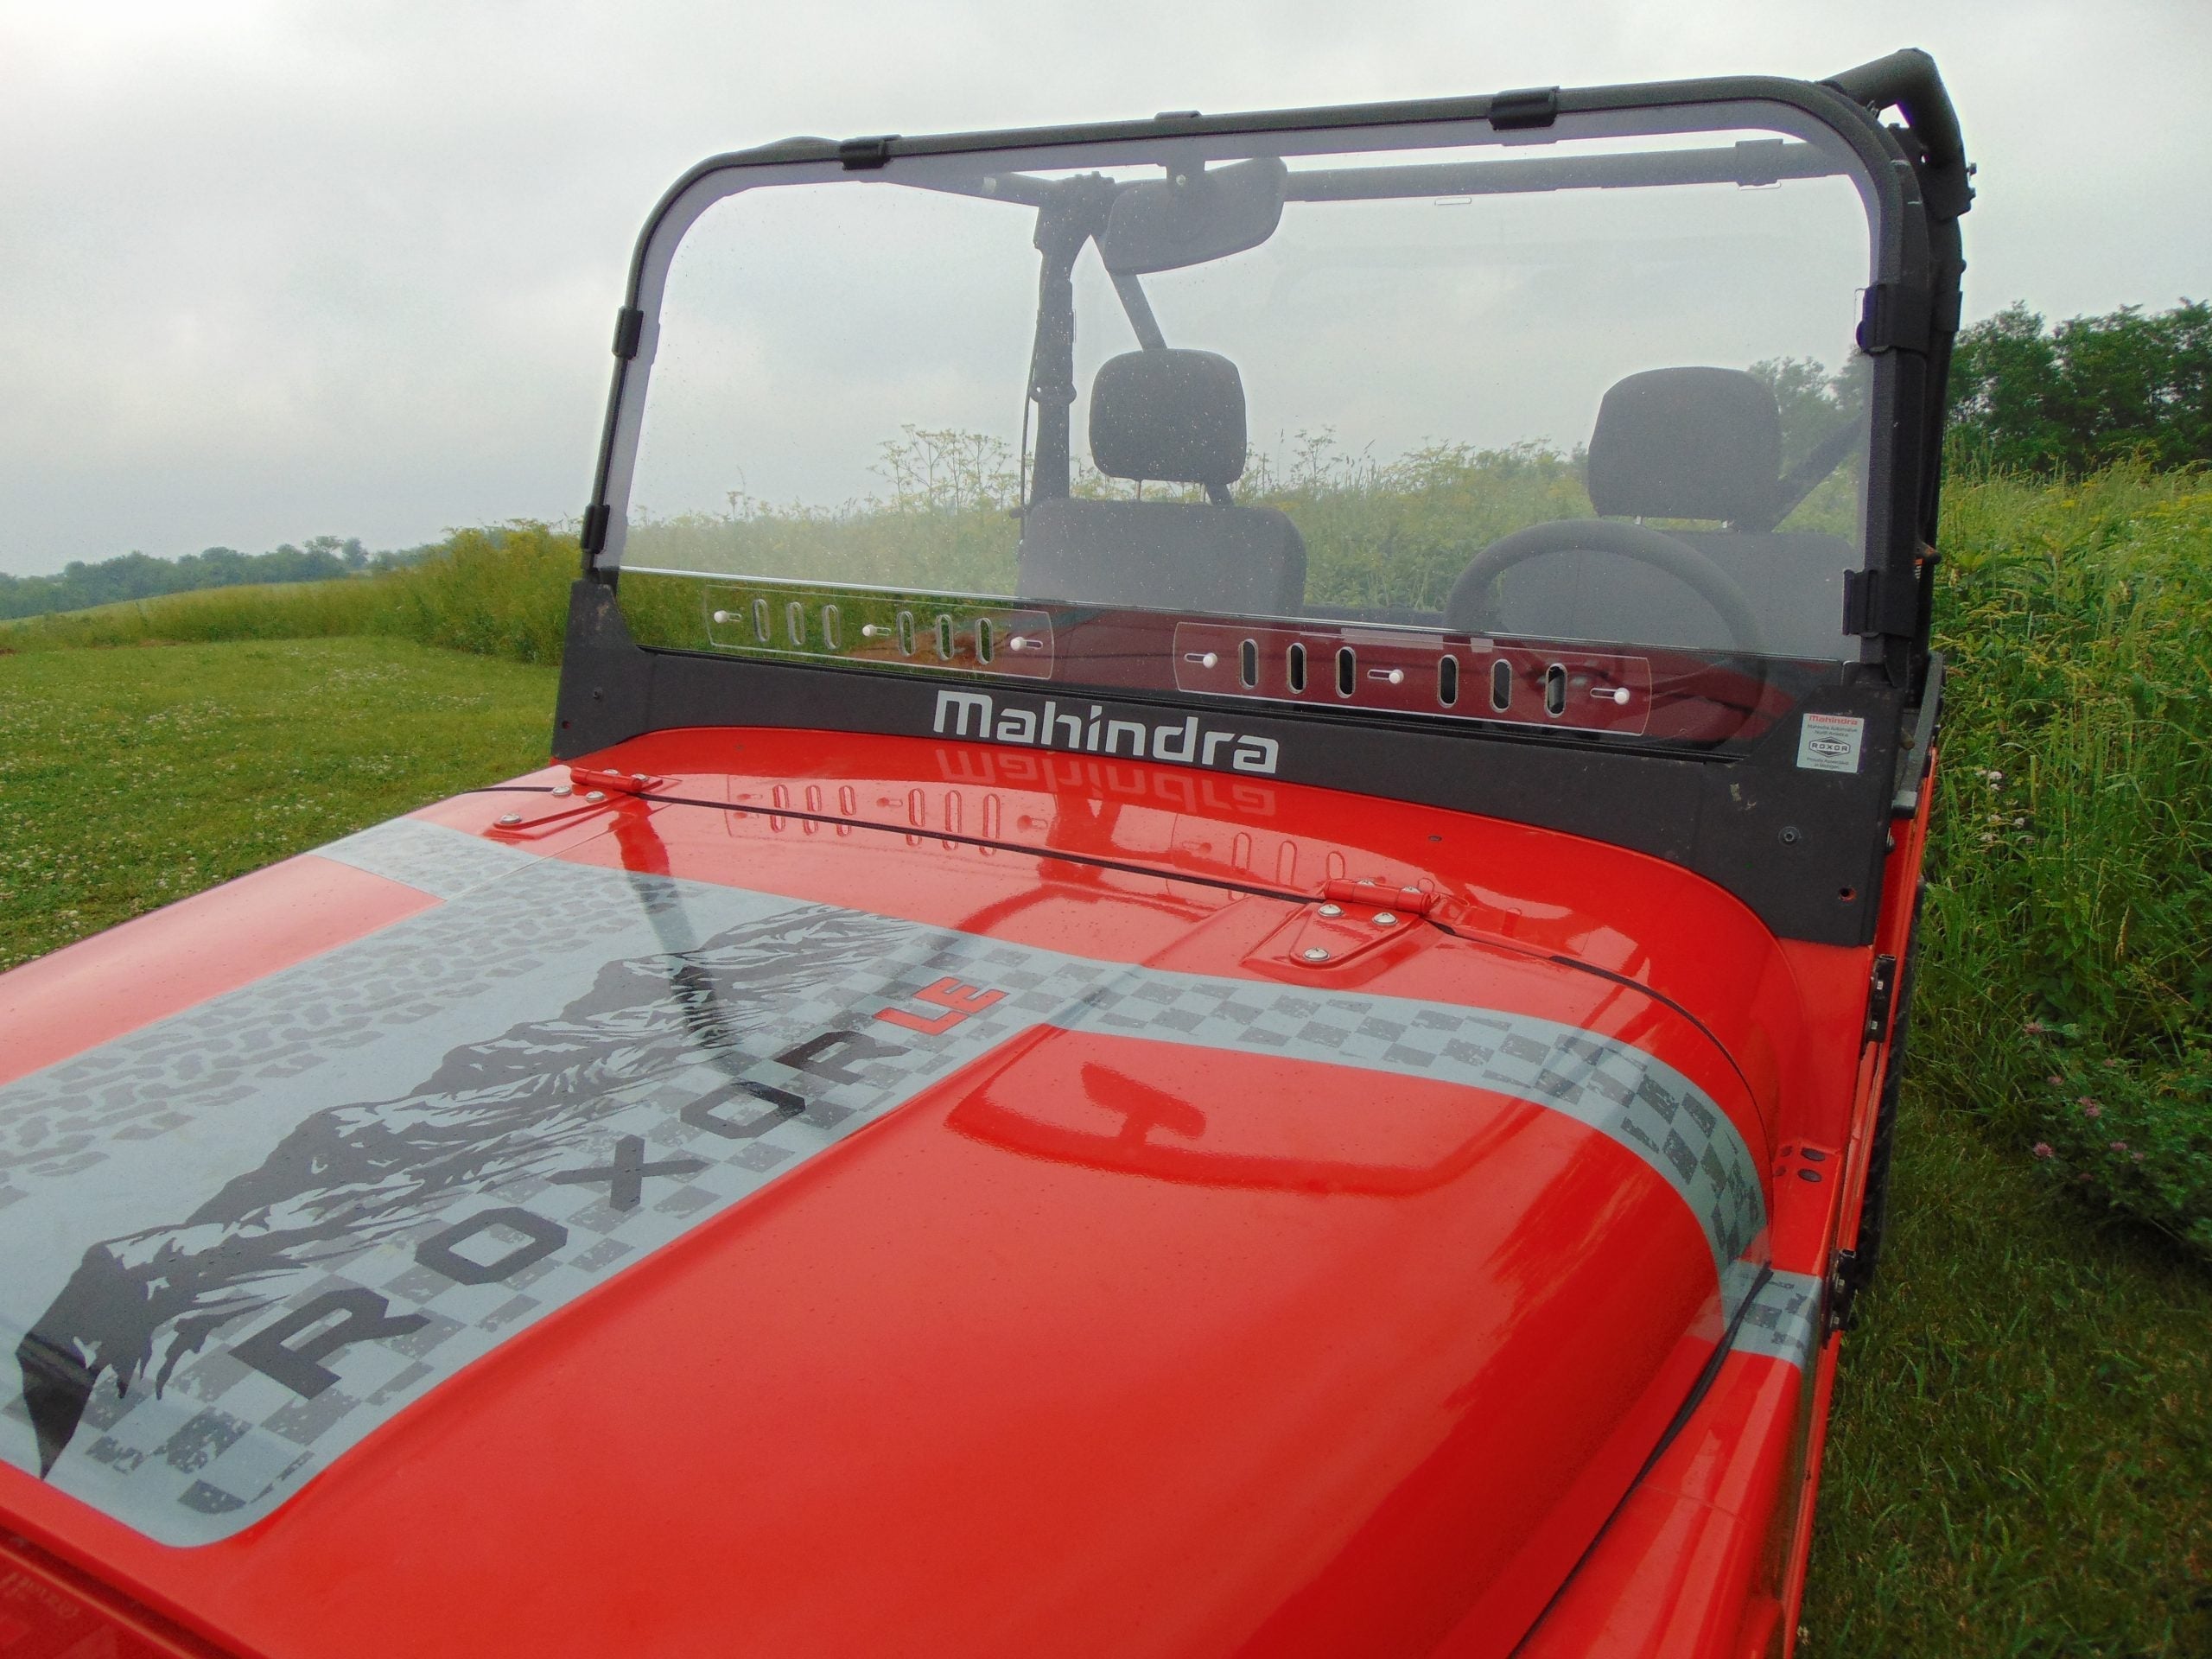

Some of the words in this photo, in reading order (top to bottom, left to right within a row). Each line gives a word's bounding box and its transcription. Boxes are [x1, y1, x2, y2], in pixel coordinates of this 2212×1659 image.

[933, 690, 1280, 774] Mahindra
[1809, 715, 1858, 725] Mahindra
[1811, 743, 1848, 752] ROXOR
[230, 1030, 912, 1400] ROXOR
[872, 976, 1010, 1036] LE
